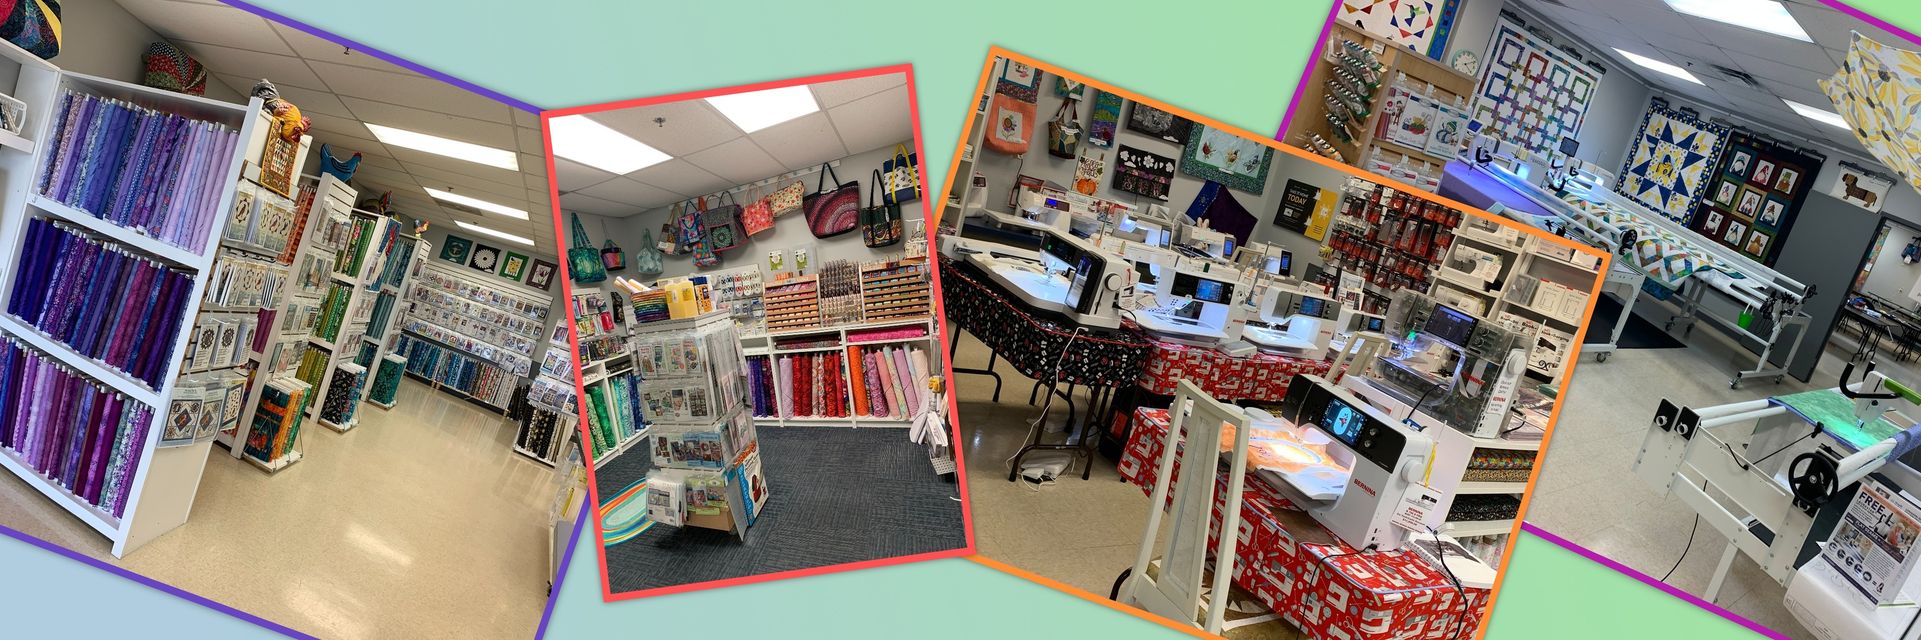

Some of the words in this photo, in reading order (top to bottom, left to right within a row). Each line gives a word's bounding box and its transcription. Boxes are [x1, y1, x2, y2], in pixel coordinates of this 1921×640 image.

[1287, 193, 1307, 205] TODAY
[1353, 478, 1376, 497] BERNINA
[1858, 491, 1886, 515] FREE
